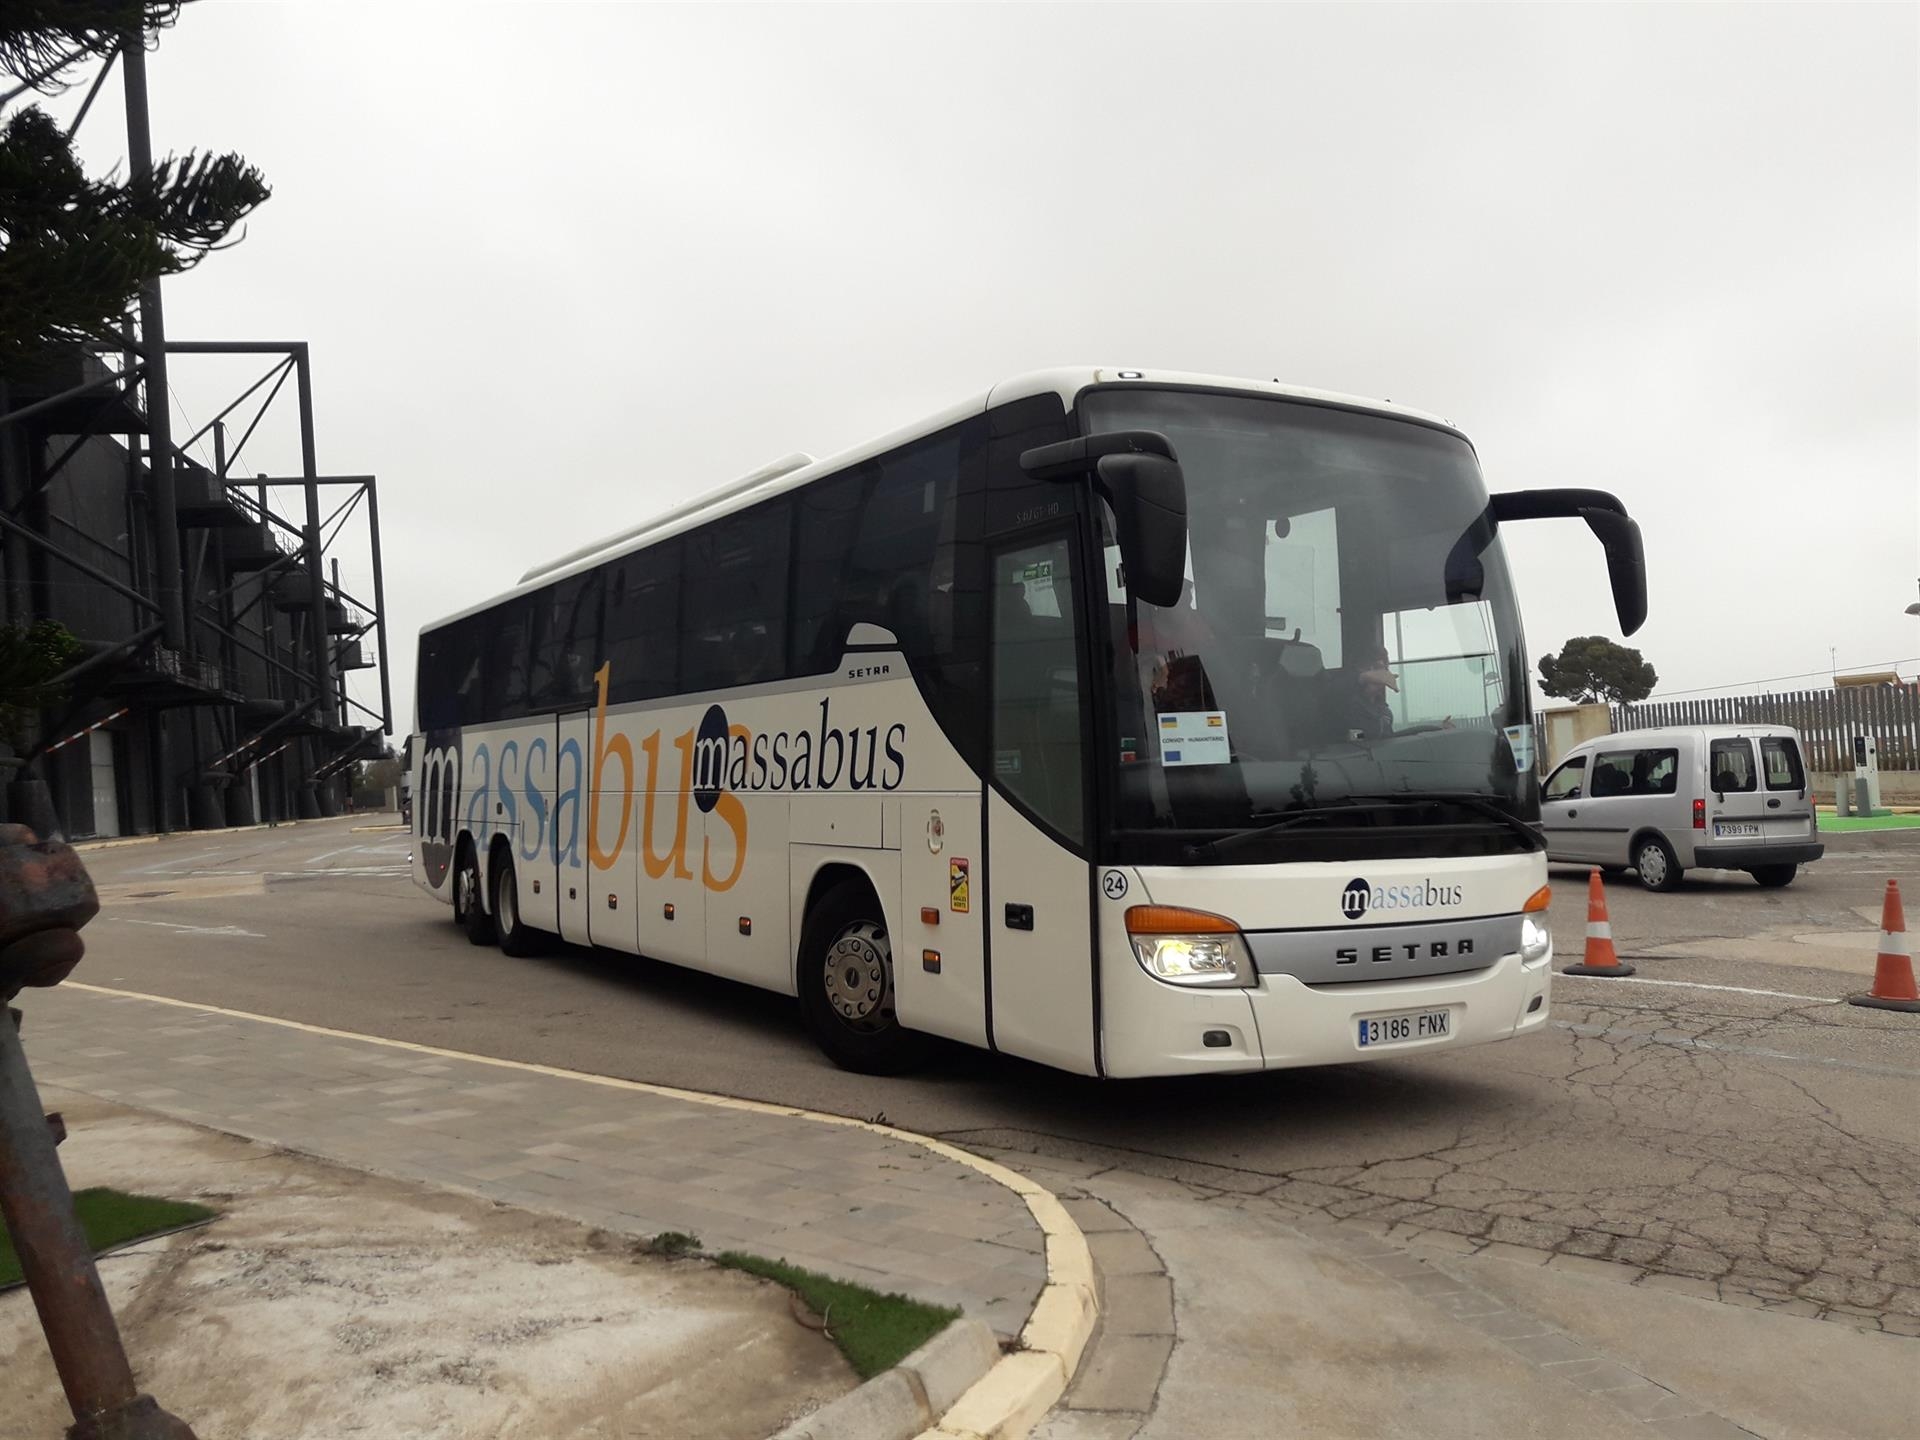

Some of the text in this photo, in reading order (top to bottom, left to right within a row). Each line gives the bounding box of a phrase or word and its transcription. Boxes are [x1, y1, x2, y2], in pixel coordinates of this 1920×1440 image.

[848, 665, 890, 678] SETRA
[694, 697, 906, 793] massabus
[421, 660, 751, 891] massabus
[1721, 825, 1742, 834] 7399
[1106, 876, 1124, 892] 24
[1342, 878, 1463, 913] massabus
[1336, 939, 1474, 965] SETRA
[1370, 1013, 1447, 1042] 3186 FNX
